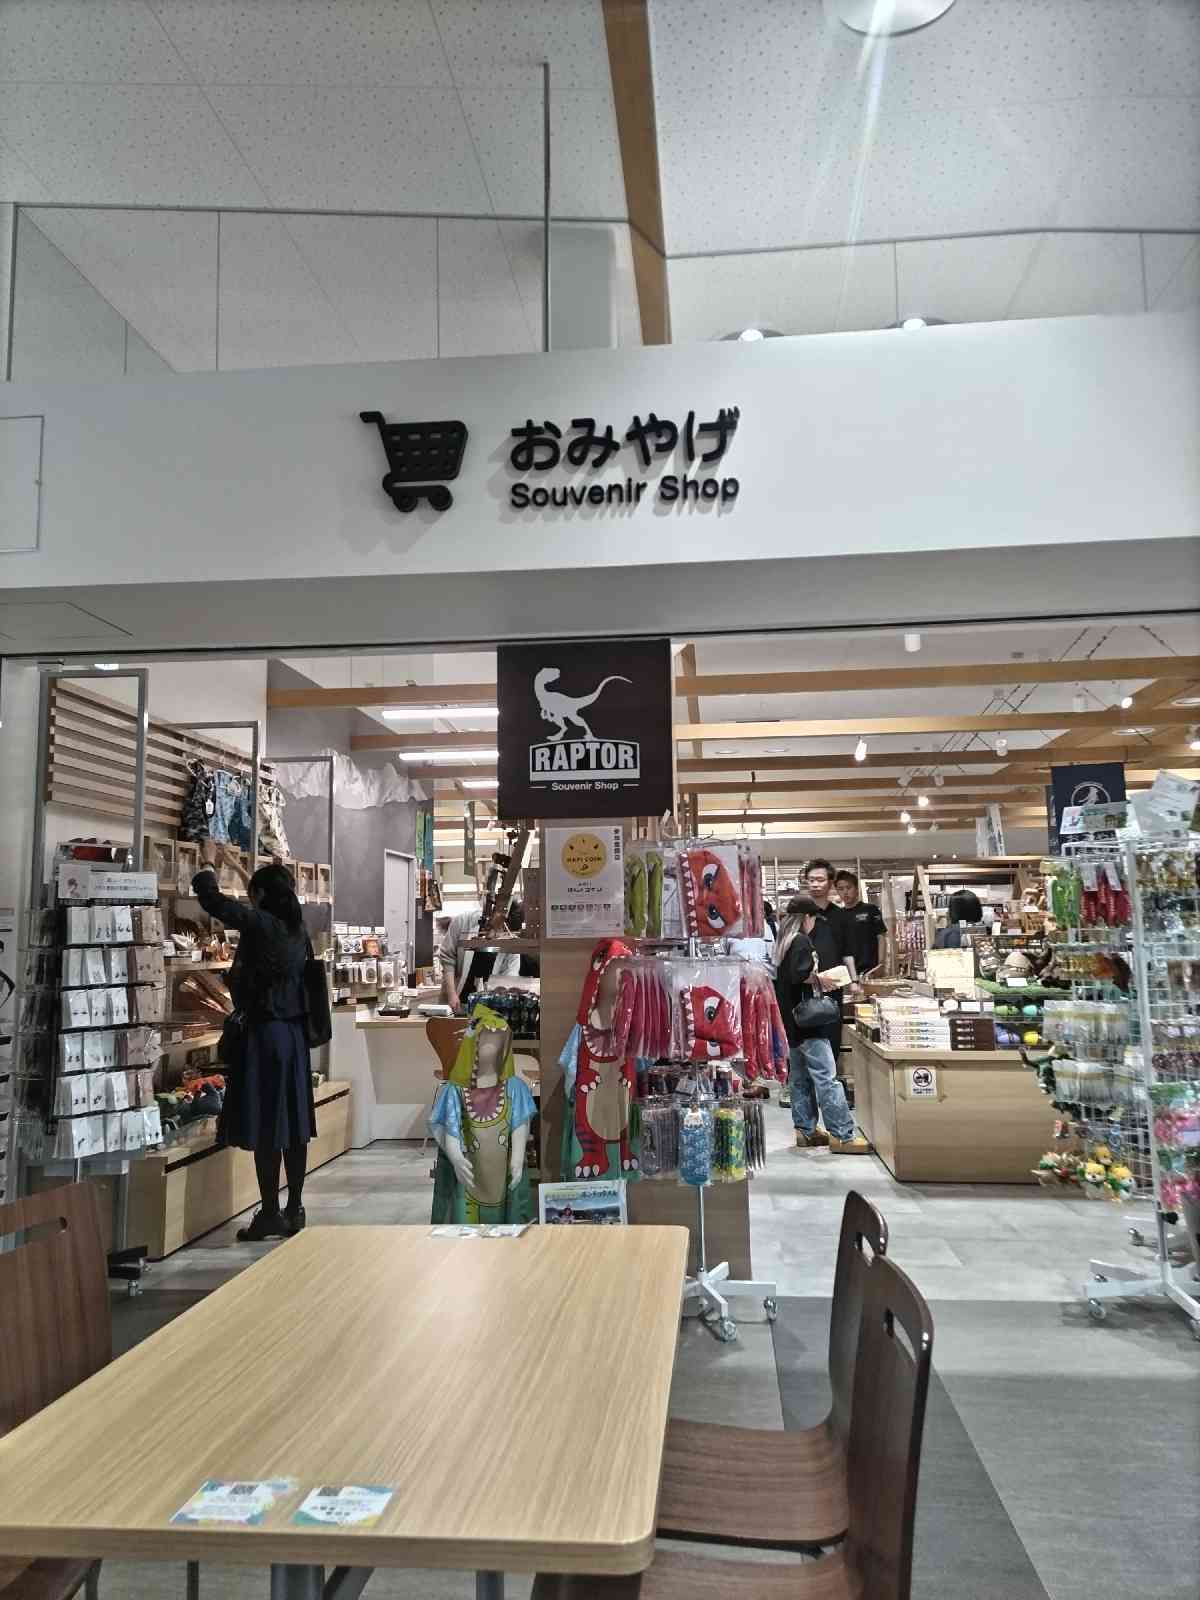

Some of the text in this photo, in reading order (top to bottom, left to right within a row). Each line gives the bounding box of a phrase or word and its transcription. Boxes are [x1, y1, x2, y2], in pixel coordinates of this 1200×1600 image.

[510, 405, 740, 471] おみやげ
[511, 474, 740, 508] Souvenir Shop
[535, 742, 634, 771] RAPTOR
[551, 781, 619, 791] Souvenir Shop
